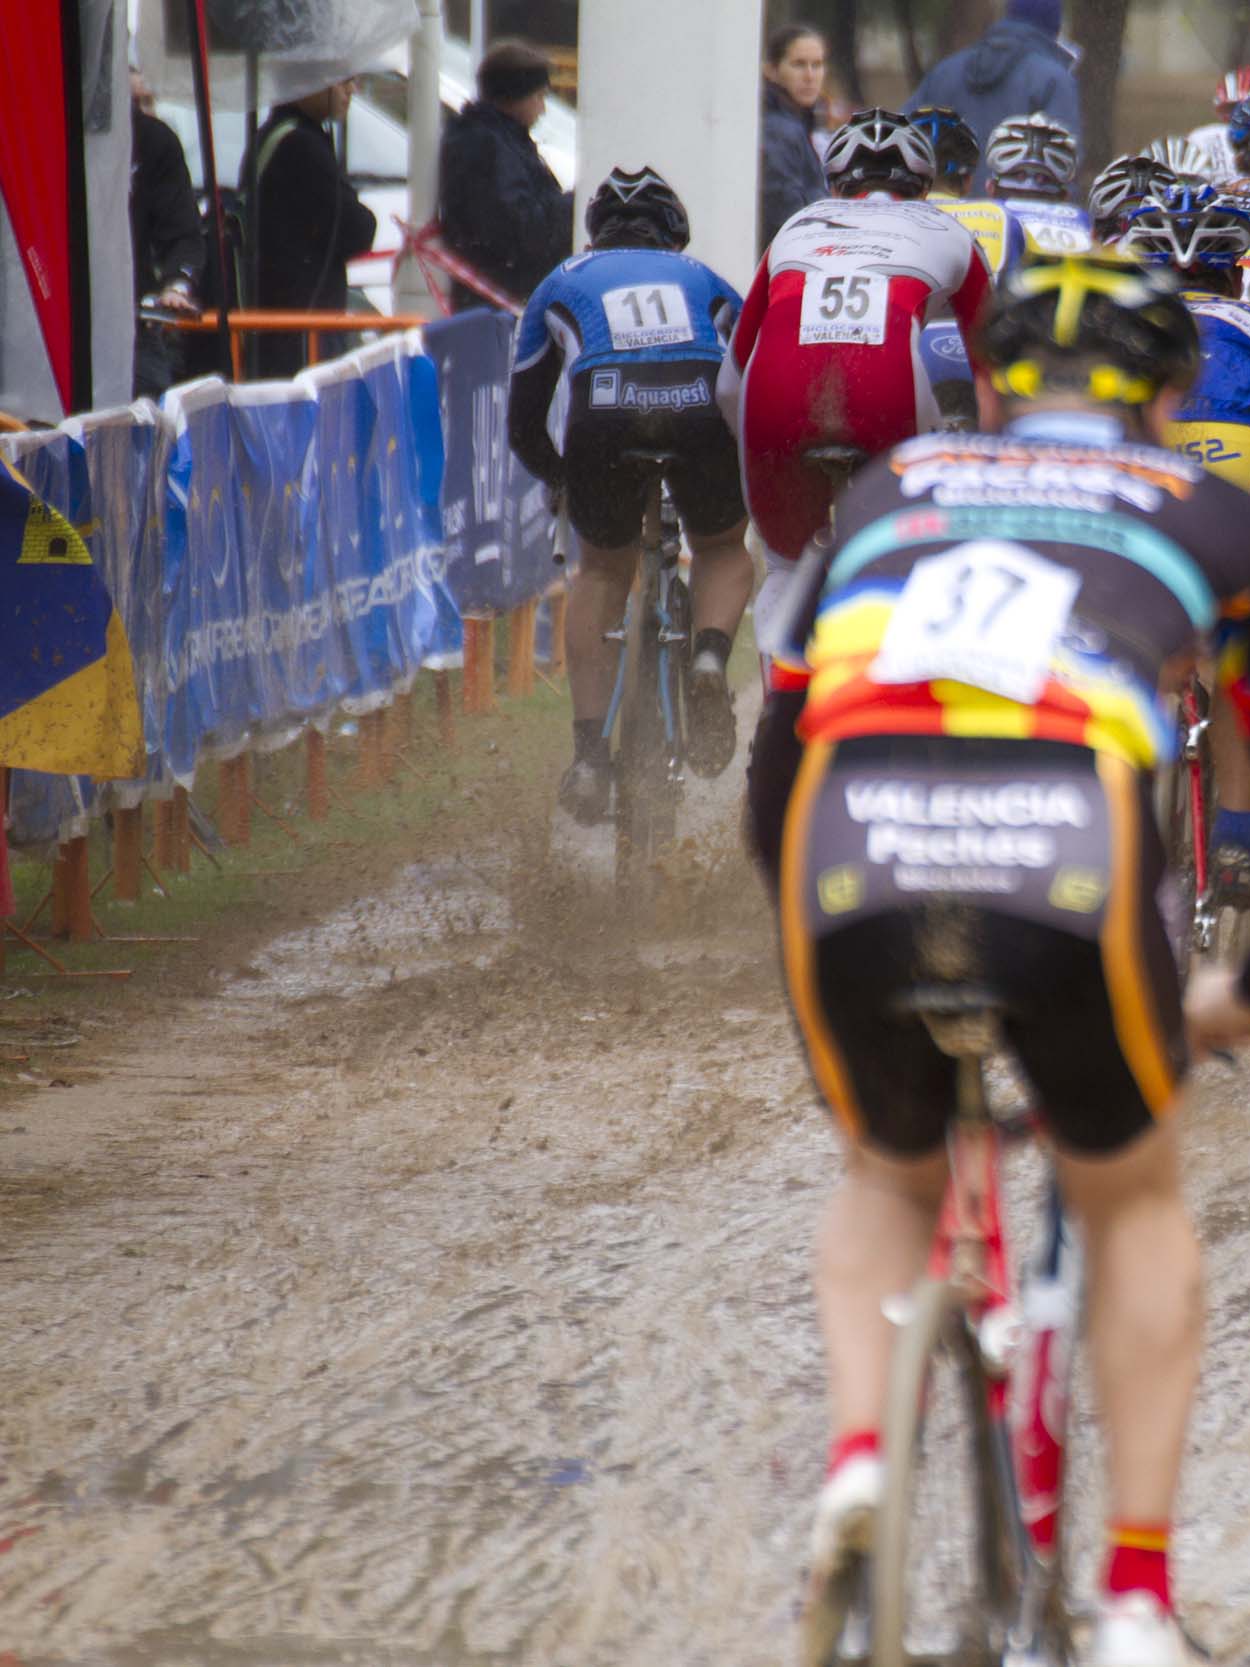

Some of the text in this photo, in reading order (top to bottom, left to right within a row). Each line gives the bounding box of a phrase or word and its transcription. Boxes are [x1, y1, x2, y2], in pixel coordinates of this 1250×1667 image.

[622, 288, 668, 327] 11
[819, 276, 871, 320] 55
[626, 335, 681, 347] VALENCIA
[622, 380, 709, 412] Aquagest
[845, 780, 1091, 829] VALENCIA
